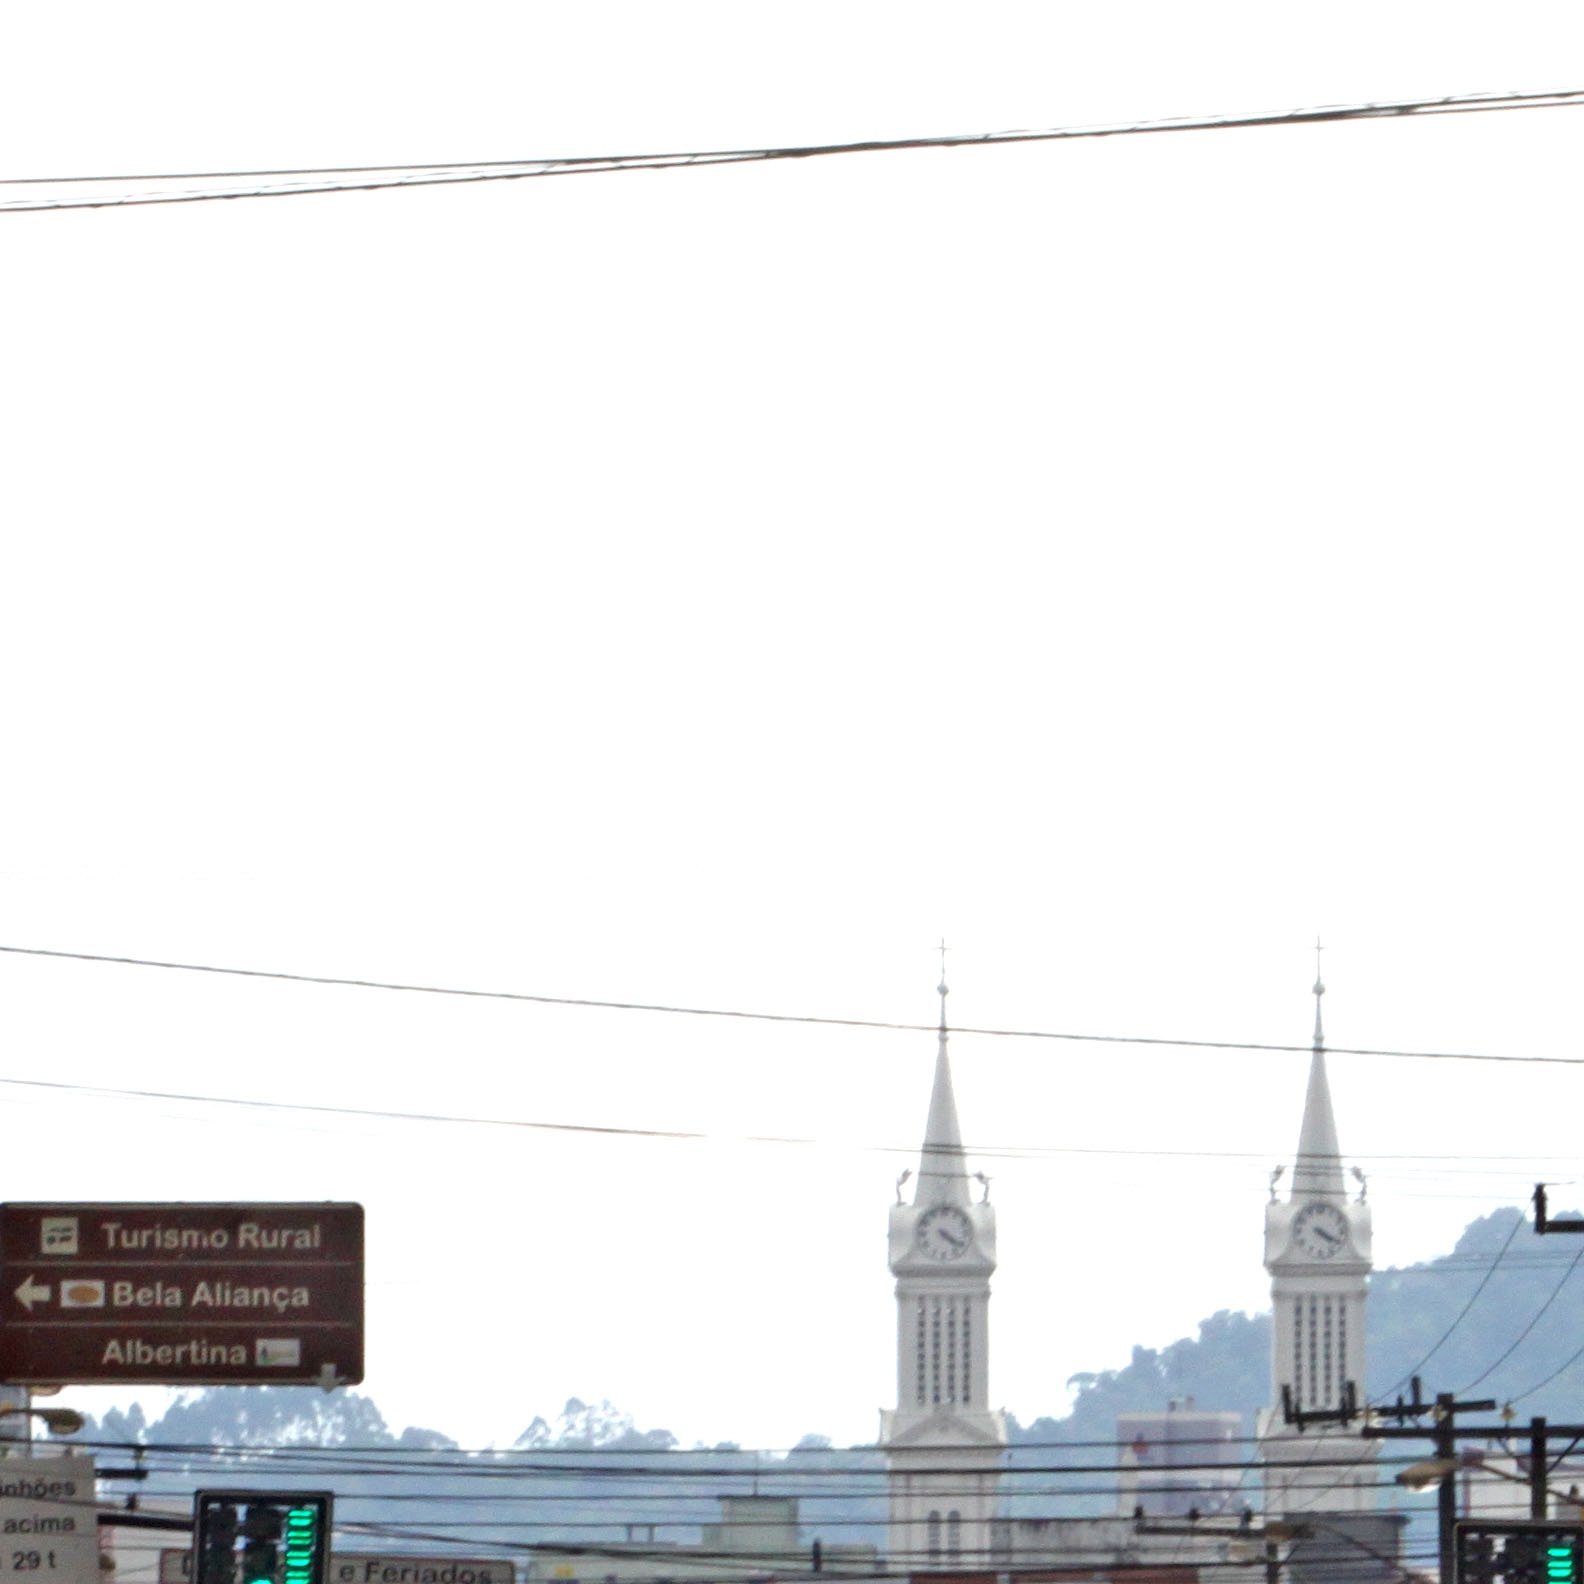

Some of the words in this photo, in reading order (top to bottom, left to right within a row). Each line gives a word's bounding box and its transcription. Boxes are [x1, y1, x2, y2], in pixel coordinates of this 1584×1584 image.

[102, 1223, 229, 1249] Turismo
[238, 1223, 321, 1249] Rural
[113, 1281, 182, 1307] Bela
[192, 1281, 310, 1313] Aliança
[102, 1339, 247, 1366] Albertina
[4, 1514, 75, 1534] acima
[13, 1552, 41, 1570] 29
[47, 1551, 57, 1569] t
[339, 1567, 354, 1581] e
